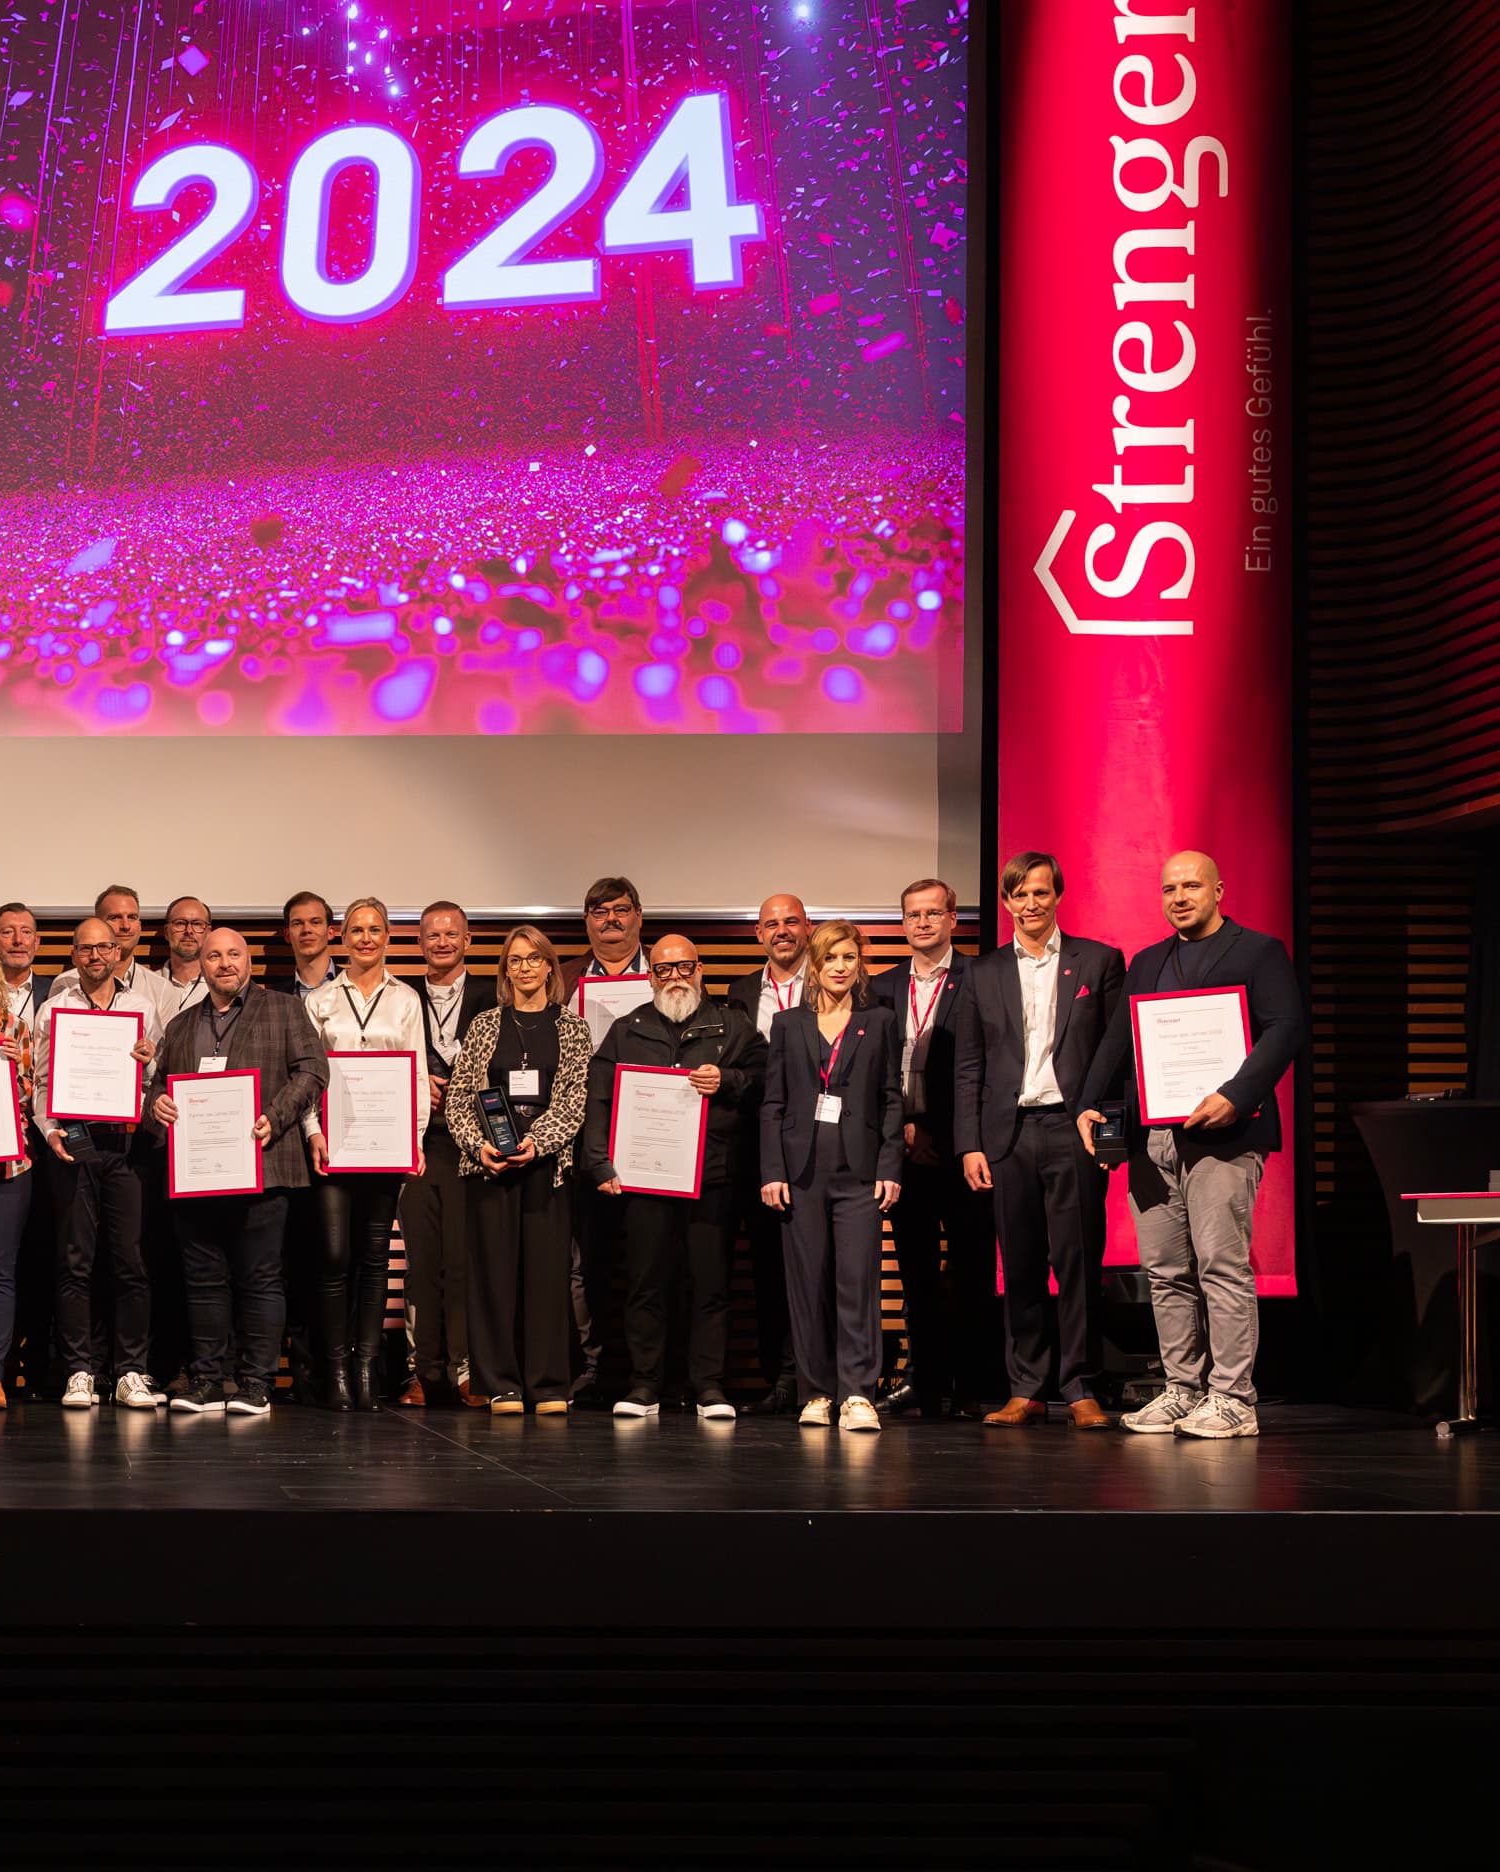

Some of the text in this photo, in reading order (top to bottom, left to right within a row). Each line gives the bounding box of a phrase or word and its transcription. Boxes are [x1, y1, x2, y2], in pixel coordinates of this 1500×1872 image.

[105, 92, 762, 335] 2024
[1245, 308, 1278, 572] Ein gutes Gefühl.
